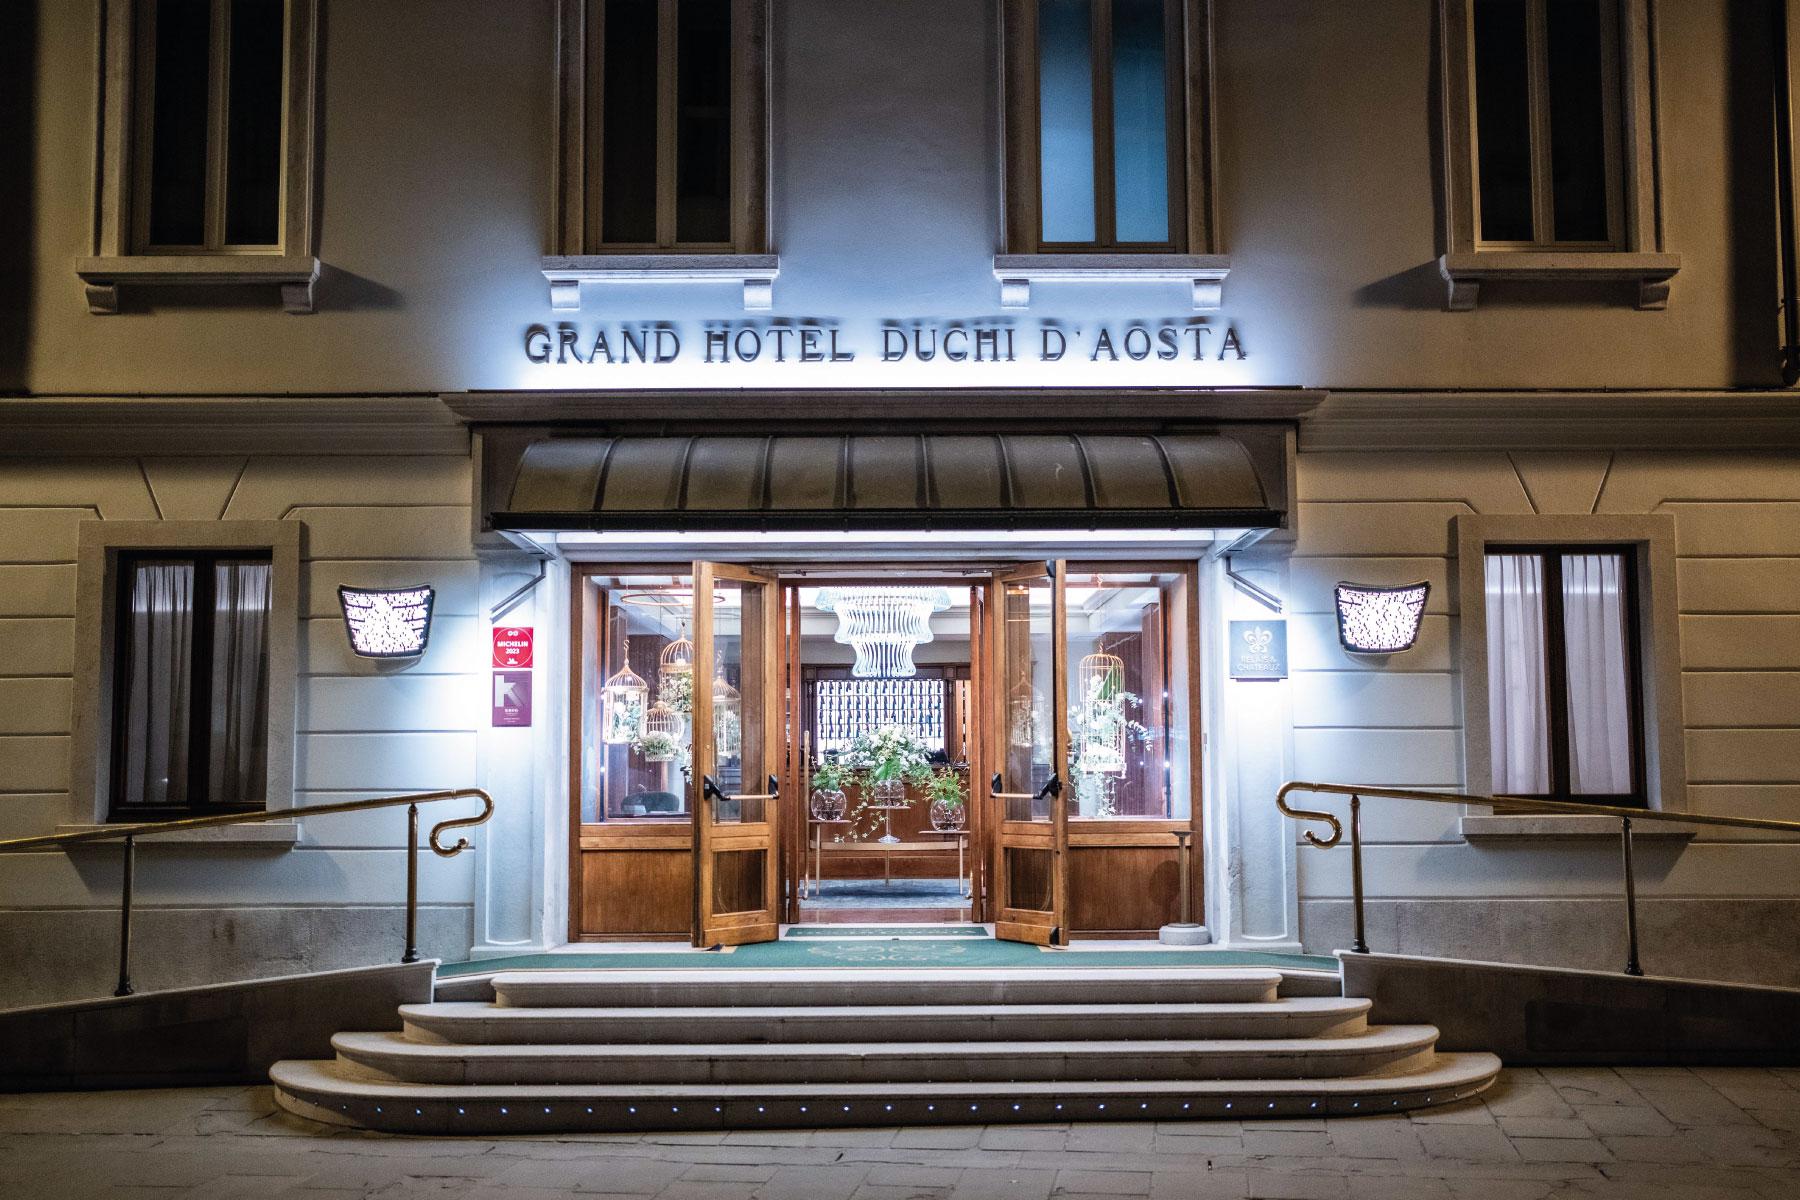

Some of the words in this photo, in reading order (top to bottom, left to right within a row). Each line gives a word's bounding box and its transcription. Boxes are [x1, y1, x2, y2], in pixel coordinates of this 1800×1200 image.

[524, 329, 681, 365] GRAND
[704, 328, 855, 363] HOTEL
[881, 327, 1016, 362] DUCHI
[1040, 326, 1247, 361] D'AOSTA
